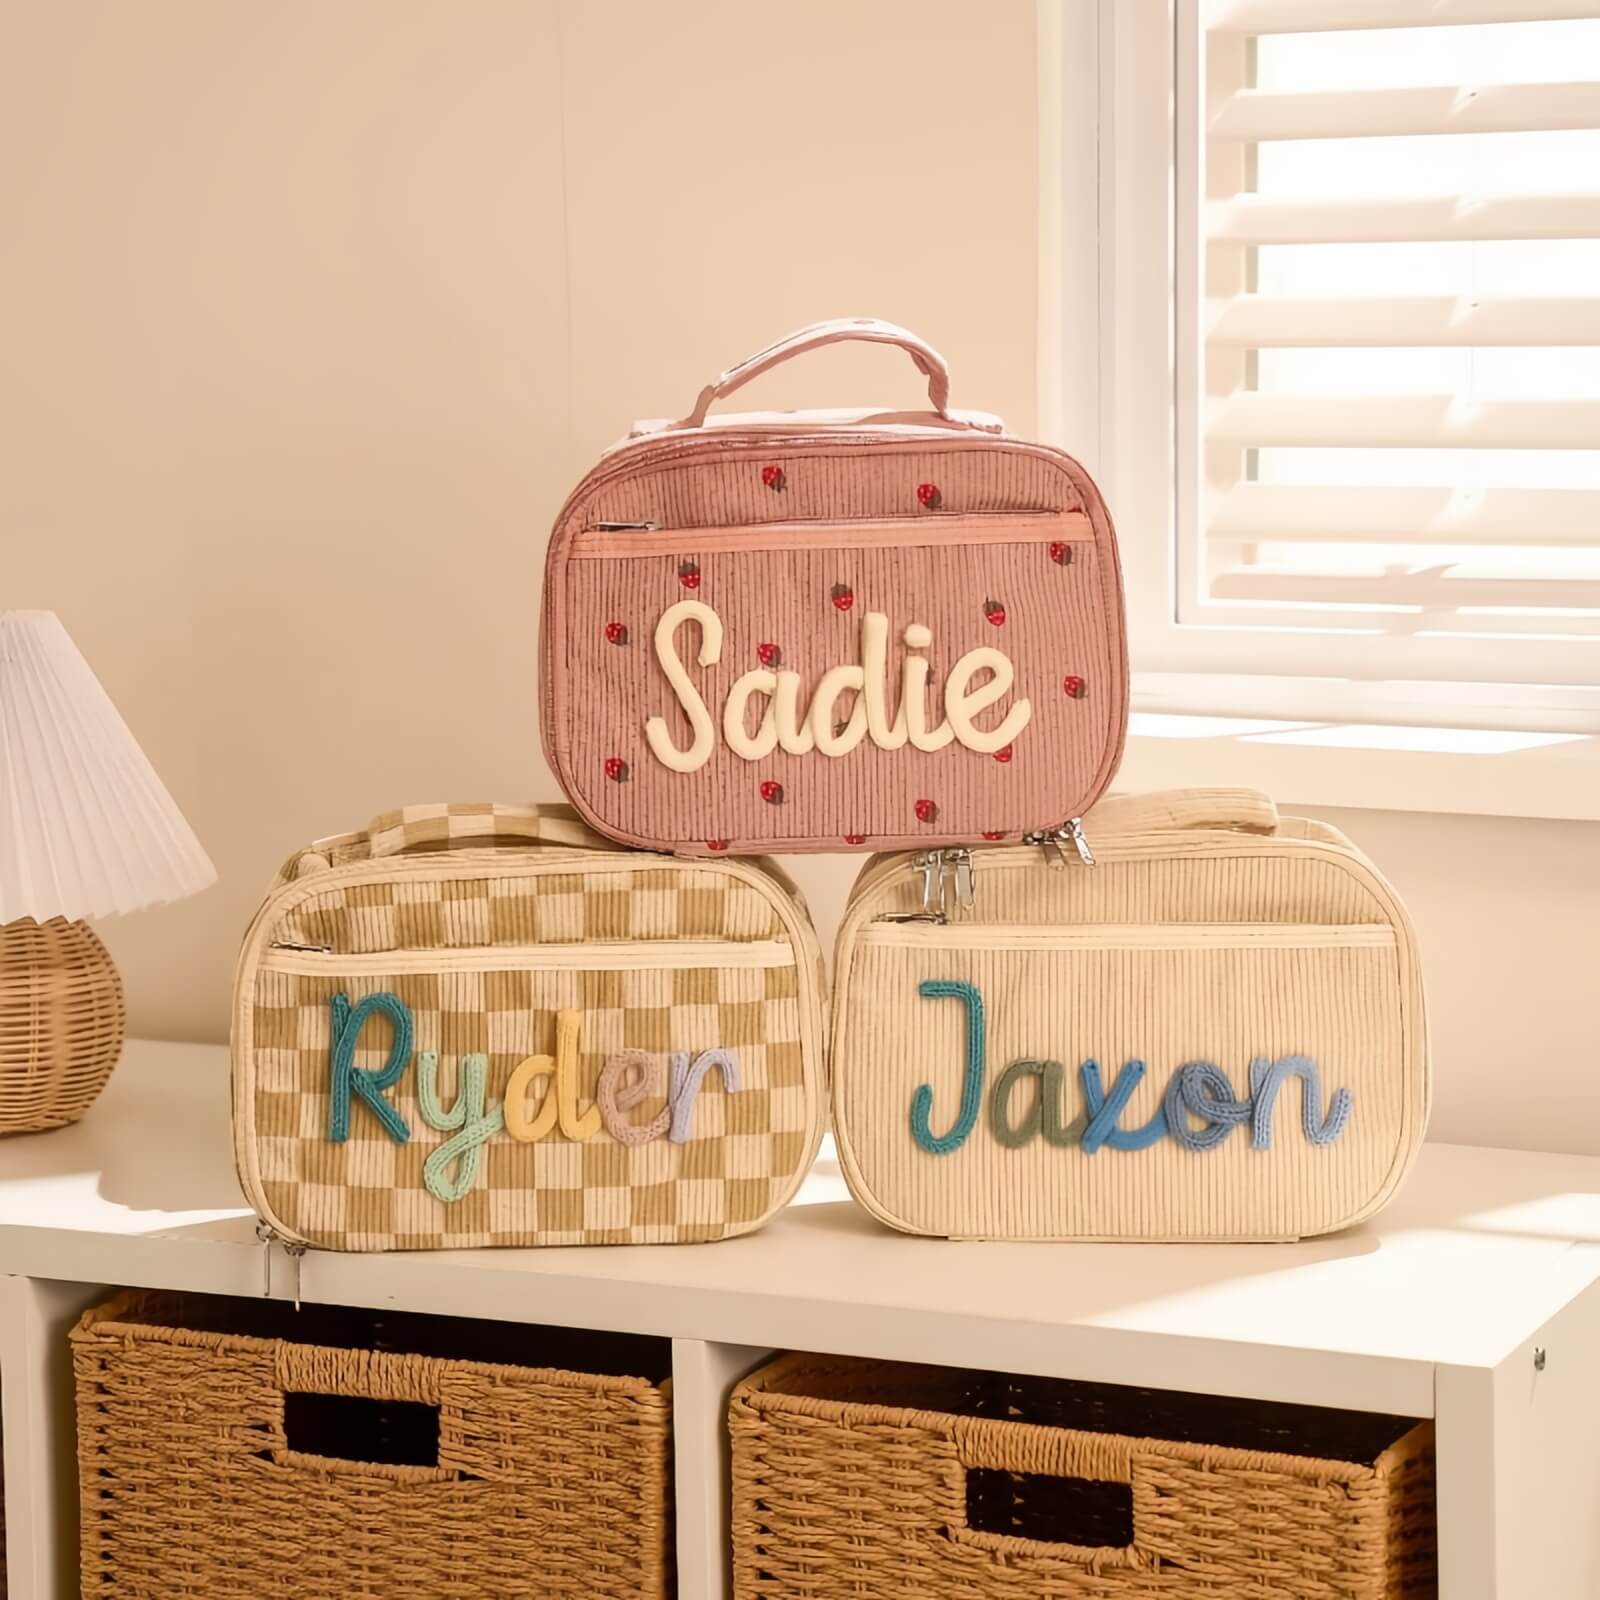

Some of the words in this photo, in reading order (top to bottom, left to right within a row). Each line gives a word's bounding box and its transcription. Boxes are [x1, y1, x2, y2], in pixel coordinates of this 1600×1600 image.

[646, 599, 1032, 773] Sadie
[329, 991, 741, 1203] Ryder
[910, 979, 1353, 1155] Jaxon
